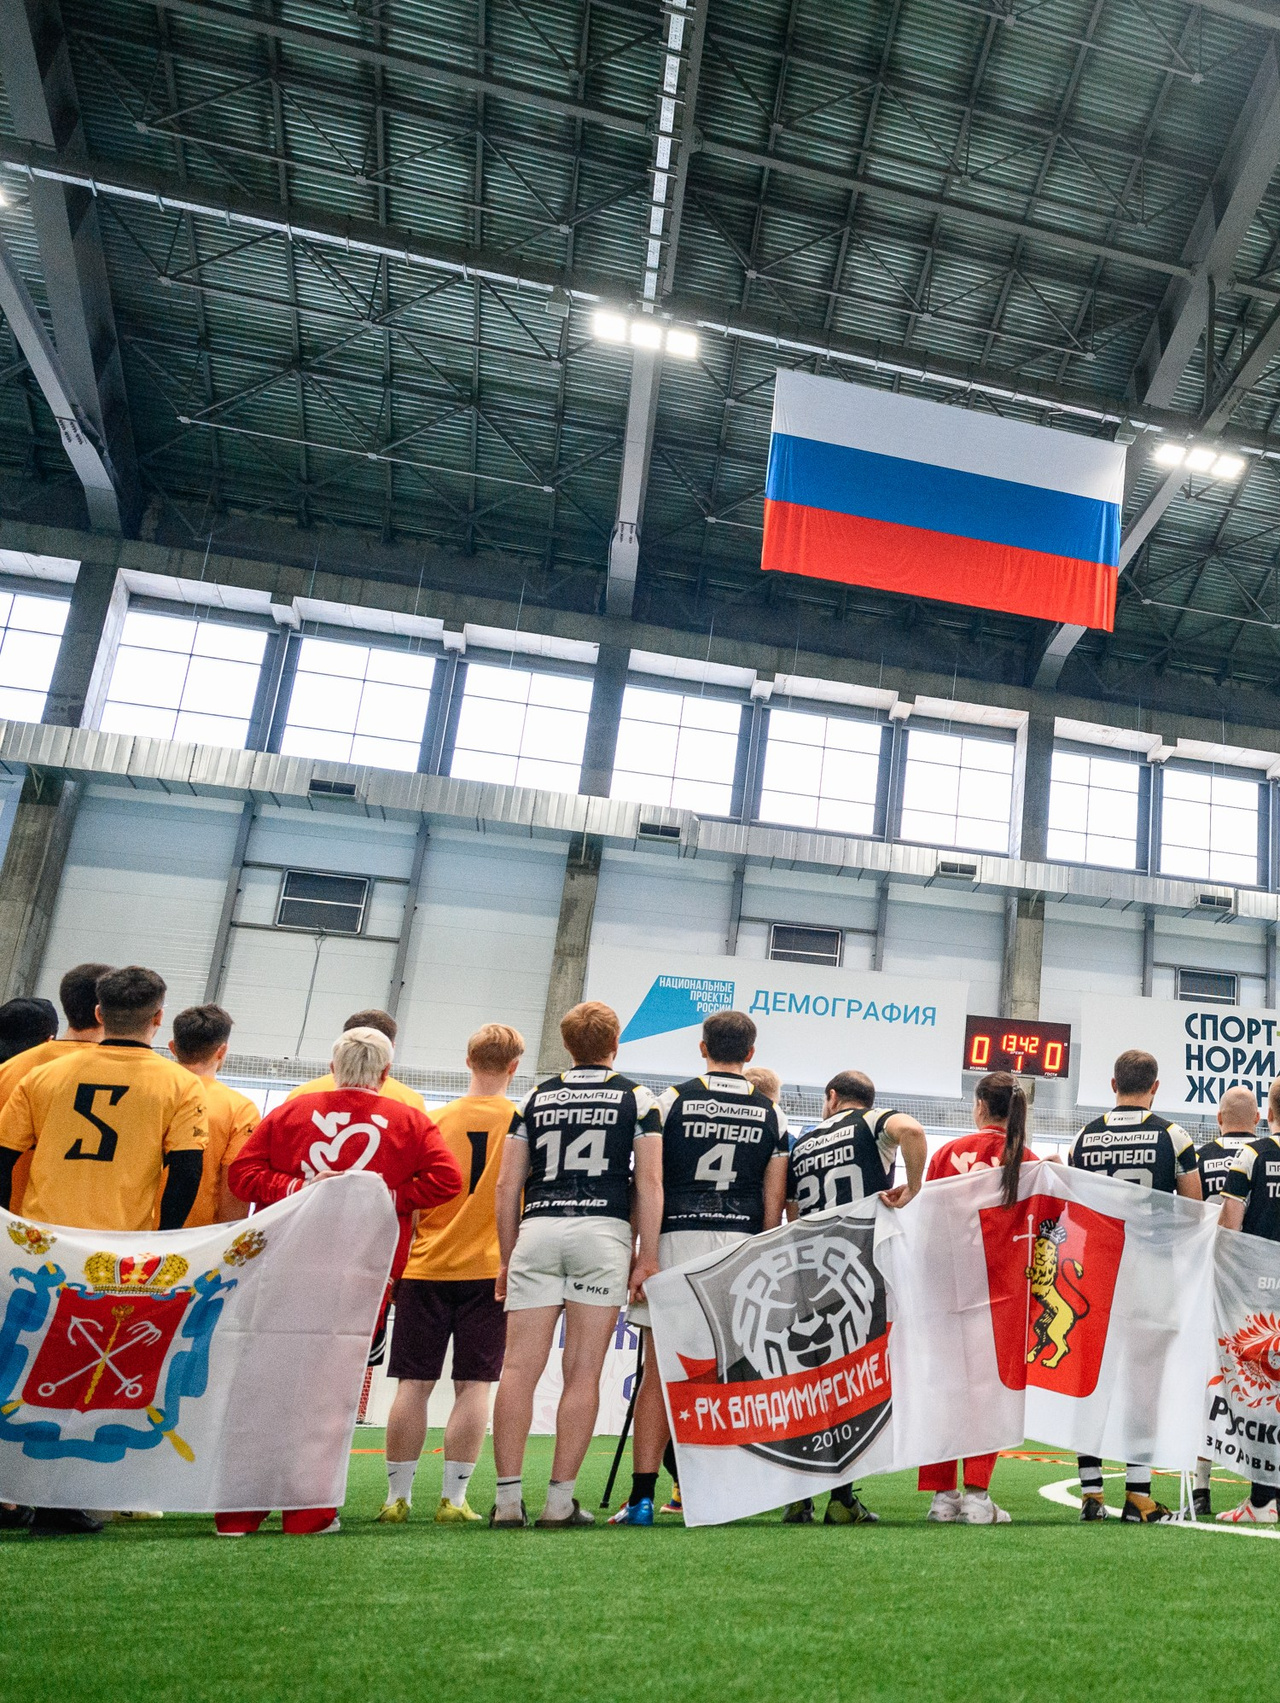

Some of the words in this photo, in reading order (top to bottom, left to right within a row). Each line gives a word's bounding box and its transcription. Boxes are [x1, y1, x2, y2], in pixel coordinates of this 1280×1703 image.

[659, 976, 734, 993] НАЦИОНАЛЬНЫЕ
[690, 990, 733, 1004] ПРОЕКТЫ
[749, 989, 938, 1026] ДЕМОГРАФИЯ
[1185, 1012, 1277, 1046] СПОРТ
[971, 1036, 990, 1064] 0
[1044, 1042, 1062, 1070] 0
[533, 1108, 618, 1128] ТОРПЕДО
[682, 1121, 763, 1144] ТОРПЕДО
[536, 1129, 610, 1182] 14
[695, 1143, 737, 1191] 4
[793, 1144, 855, 1177] ТОРПЕДО
[1082, 1149, 1157, 1167] ТОРПЕДО
[797, 1163, 865, 1213] 20
[586, 1285, 610, 1295] МКБ
[694, 1396, 727, 1431] РК
[728, 1353, 884, 1432] ВЛАДИМИРСКИЕ
[812, 1424, 852, 1452] 2010
